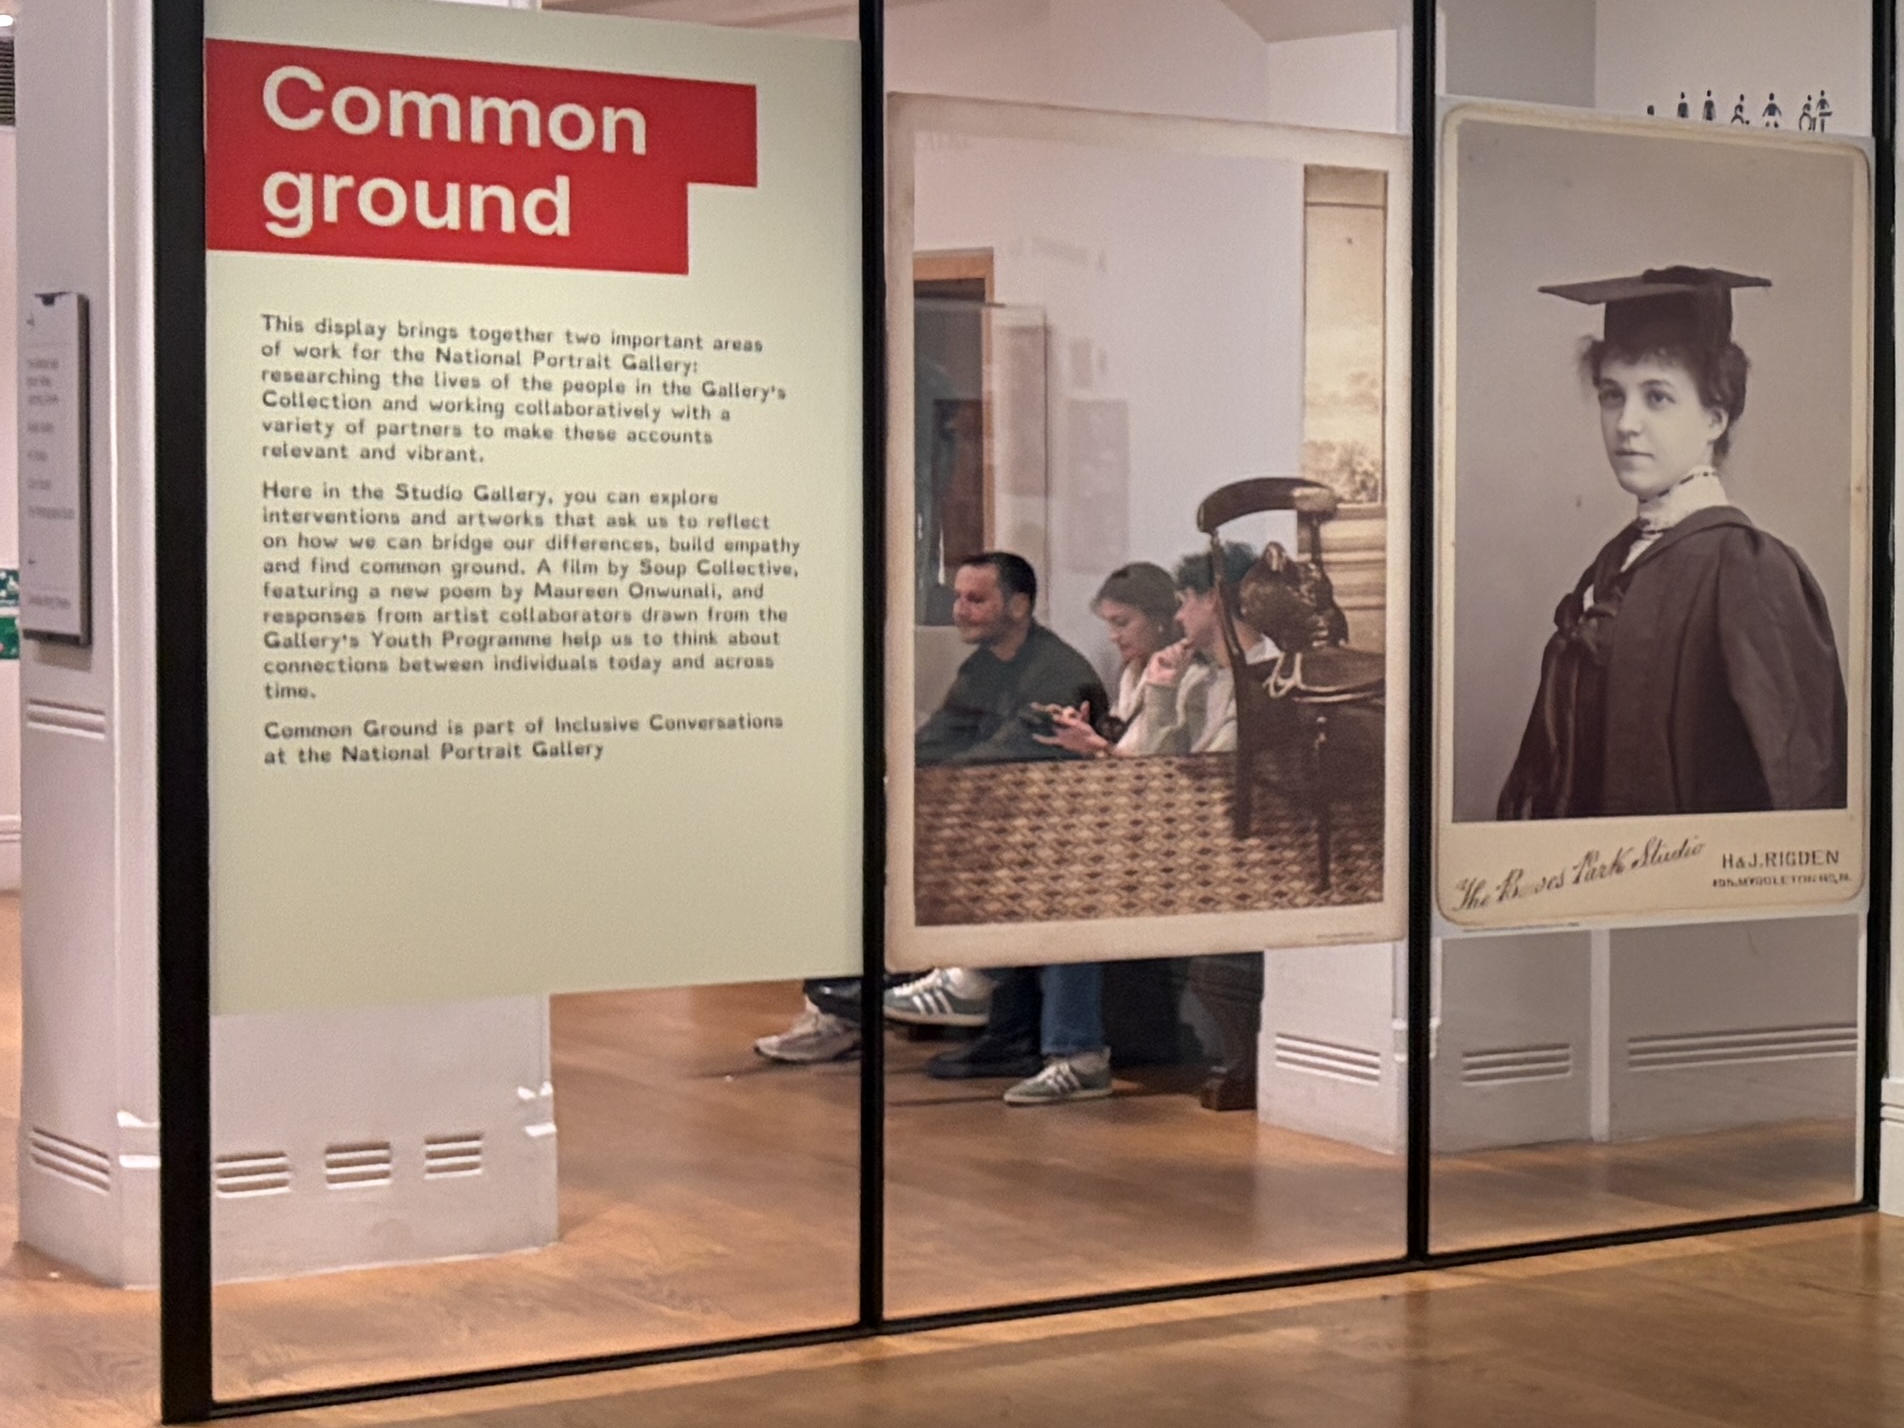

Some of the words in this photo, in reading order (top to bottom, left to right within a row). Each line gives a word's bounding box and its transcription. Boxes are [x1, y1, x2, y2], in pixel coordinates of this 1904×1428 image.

[263, 65, 647, 155] Common
[262, 171, 571, 239] ground
[261, 313, 305, 334] This
[313, 316, 388, 342] display
[397, 319, 460, 345] brings
[468, 324, 555, 347] together
[564, 328, 602, 347] two
[610, 329, 704, 352] important
[712, 338, 764, 353] areas
[260, 339, 282, 358] of
[292, 341, 342, 360] work
[351, 341, 382, 362] for
[391, 344, 426, 364] the
[434, 342, 522, 368] National
[532, 348, 612, 371] Portrait
[260, 367, 382, 393] researching
[391, 369, 425, 388] the
[433, 370, 482, 390] lives
[489, 372, 511, 391] of
[520, 373, 554, 393] the
[561, 376, 627, 399] people
[635, 377, 653, 396] in
[661, 379, 693, 398] the
[261, 387, 373, 412] Collection
[381, 393, 419, 413] and
[428, 395, 506, 421] working
[513, 398, 662, 424] collaboratively
[670, 403, 712, 421] with
[720, 409, 731, 422] a
[261, 415, 335, 440] variety
[344, 417, 366, 436] of
[375, 420, 463, 443] partners
[472, 422, 495, 440] to
[503, 422, 555, 441] make
[563, 423, 617, 443] these
[626, 429, 714, 445] accounts
[261, 440, 350, 460] relevant
[358, 442, 397, 462] and
[261, 479, 313, 500] Here
[322, 481, 341, 500] in
[350, 481, 385, 502] the
[394, 482, 464, 503] Studio
[563, 490, 598, 509] you
[605, 491, 641, 505] can
[648, 488, 719, 510] explore
[262, 505, 401, 526] interventions
[410, 507, 448, 527] and
[456, 509, 545, 528] artworks
[554, 509, 597, 529] that
[605, 511, 638, 529] ask
[646, 516, 669, 529] us
[677, 513, 699, 530] to
[706, 512, 770, 531] reflect
[261, 535, 289, 550] on
[296, 531, 339, 550] how
[348, 536, 377, 551] we
[385, 536, 423, 551] can
[431, 532, 494, 557] bridge
[502, 537, 536, 552] our
[668, 535, 715, 554] build
[723, 536, 801, 559] empathy
[262, 555, 301, 575] and
[310, 555, 351, 575] find
[359, 561, 442, 576] common
[535, 557, 552, 576] A
[561, 557, 599, 576] film
[607, 558, 630, 582] by
[639, 557, 688, 581] Soup
[262, 580, 359, 605] featuring
[368, 586, 381, 600] a
[389, 585, 430, 600] new
[439, 585, 493, 605] poem
[500, 581, 524, 605] by
[532, 581, 619, 600] Maureen
[731, 582, 765, 601] and
[262, 610, 367, 630] responses
[376, 605, 424, 625] from
[432, 606, 490, 625] artist
[498, 605, 633, 625] collaborators
[640, 605, 699, 624] drawn
[707, 605, 750, 624] from
[757, 605, 788, 623] the
[370, 630, 433, 650] Youth
[441, 629, 553, 654] Programme
[561, 629, 603, 652] help
[610, 633, 634, 647] us
[642, 631, 664, 648] to
[672, 629, 719, 647] think
[727, 629, 780, 647] about
[262, 655, 390, 676] connections
[398, 655, 485, 674] between
[493, 653, 599, 672] individuals
[607, 652, 662, 676] today
[671, 652, 706, 670] and
[713, 656, 775, 670] across
[263, 720, 353, 741] Common
[362, 718, 439, 739] Ground
[447, 718, 465, 737] is
[472, 719, 515, 740] part
[524, 716, 545, 735] of
[554, 715, 640, 734] Inclusive
[648, 712, 784, 732] Conversations
[263, 746, 287, 766] at
[297, 745, 332, 765] the
[340, 743, 430, 763] National
[440, 741, 522, 761] Portrait
[531, 739, 604, 762] Gallery
[1631, 835, 1706, 871] Studio
